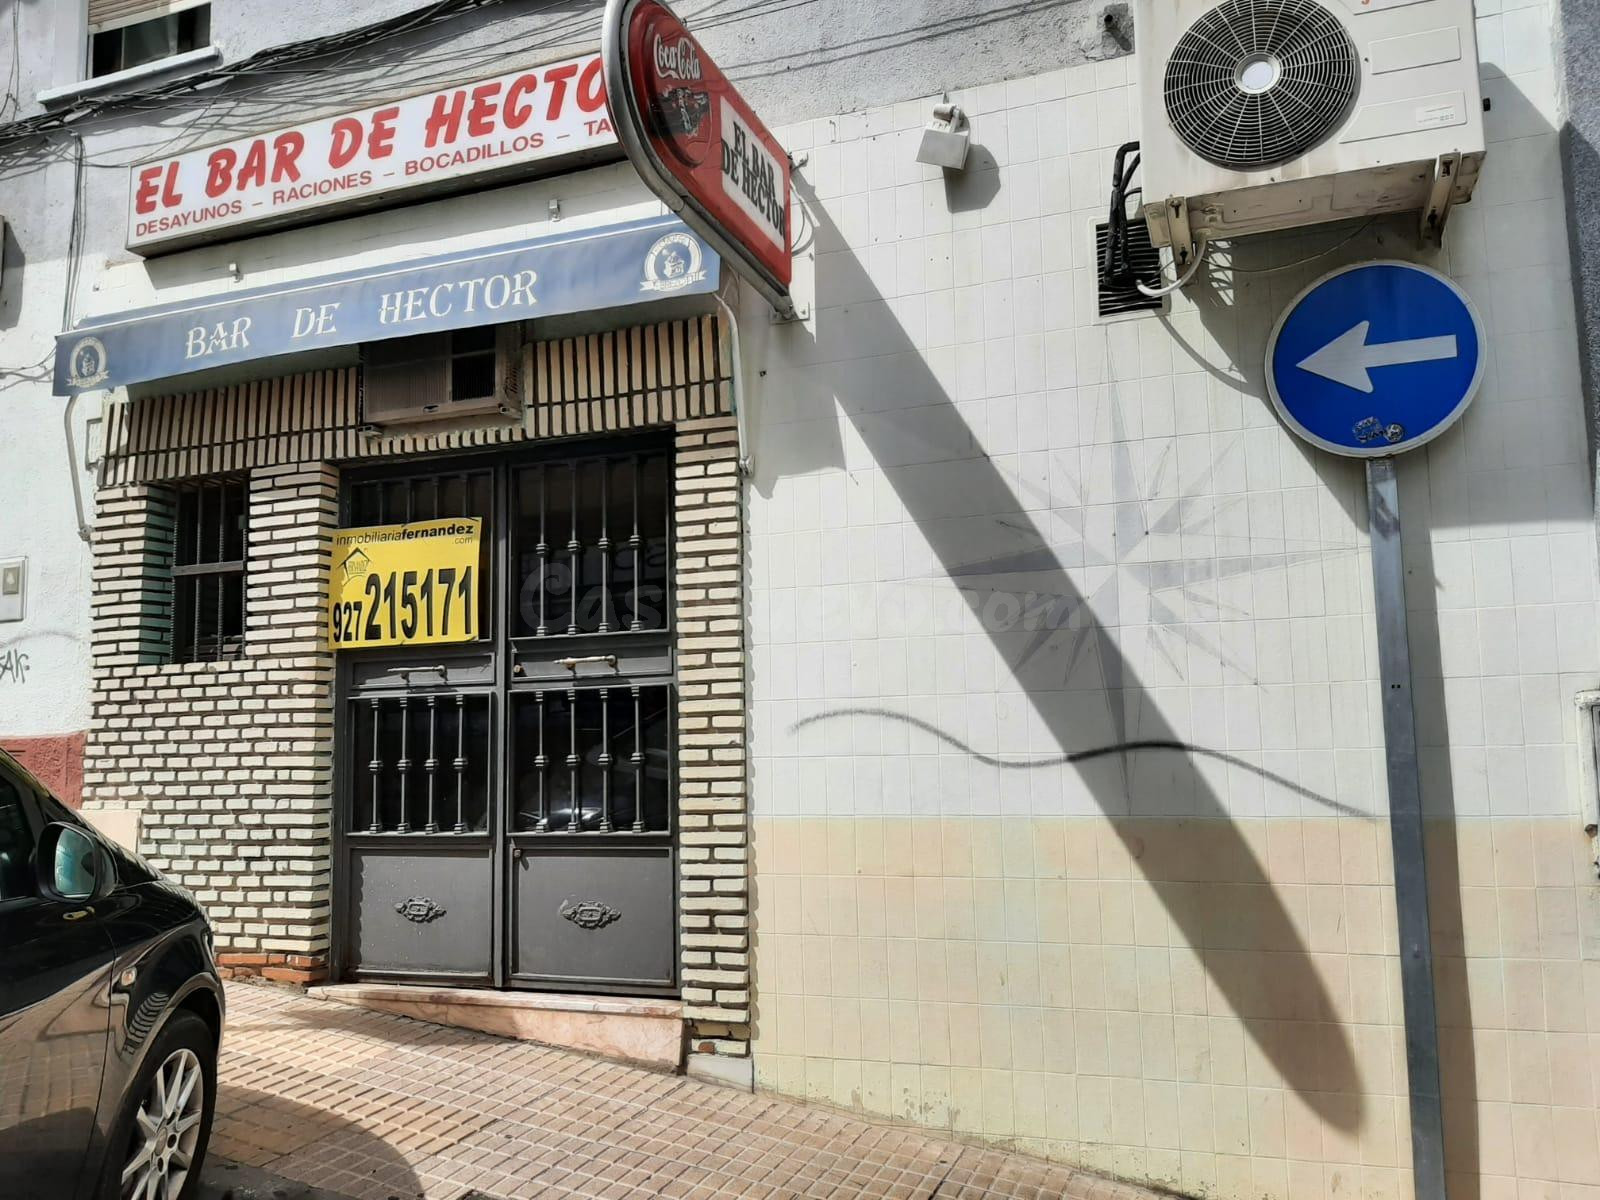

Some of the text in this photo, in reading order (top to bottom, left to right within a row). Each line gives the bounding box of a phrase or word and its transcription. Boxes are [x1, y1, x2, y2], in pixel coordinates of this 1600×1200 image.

[136, 161, 183, 215] EL
[205, 131, 305, 198] BAR
[328, 106, 400, 169] DE
[136, 200, 242, 237] DESAYUNOS
[272, 170, 372, 205] RACIONES
[405, 132, 544, 176] BOCADILLOS
[720, 137, 785, 240] DE HECTOR
[733, 121, 776, 199] EL BAR
[184, 270, 539, 359] BAR DE HECTOR
[333, 566, 472, 642] 927 215171
